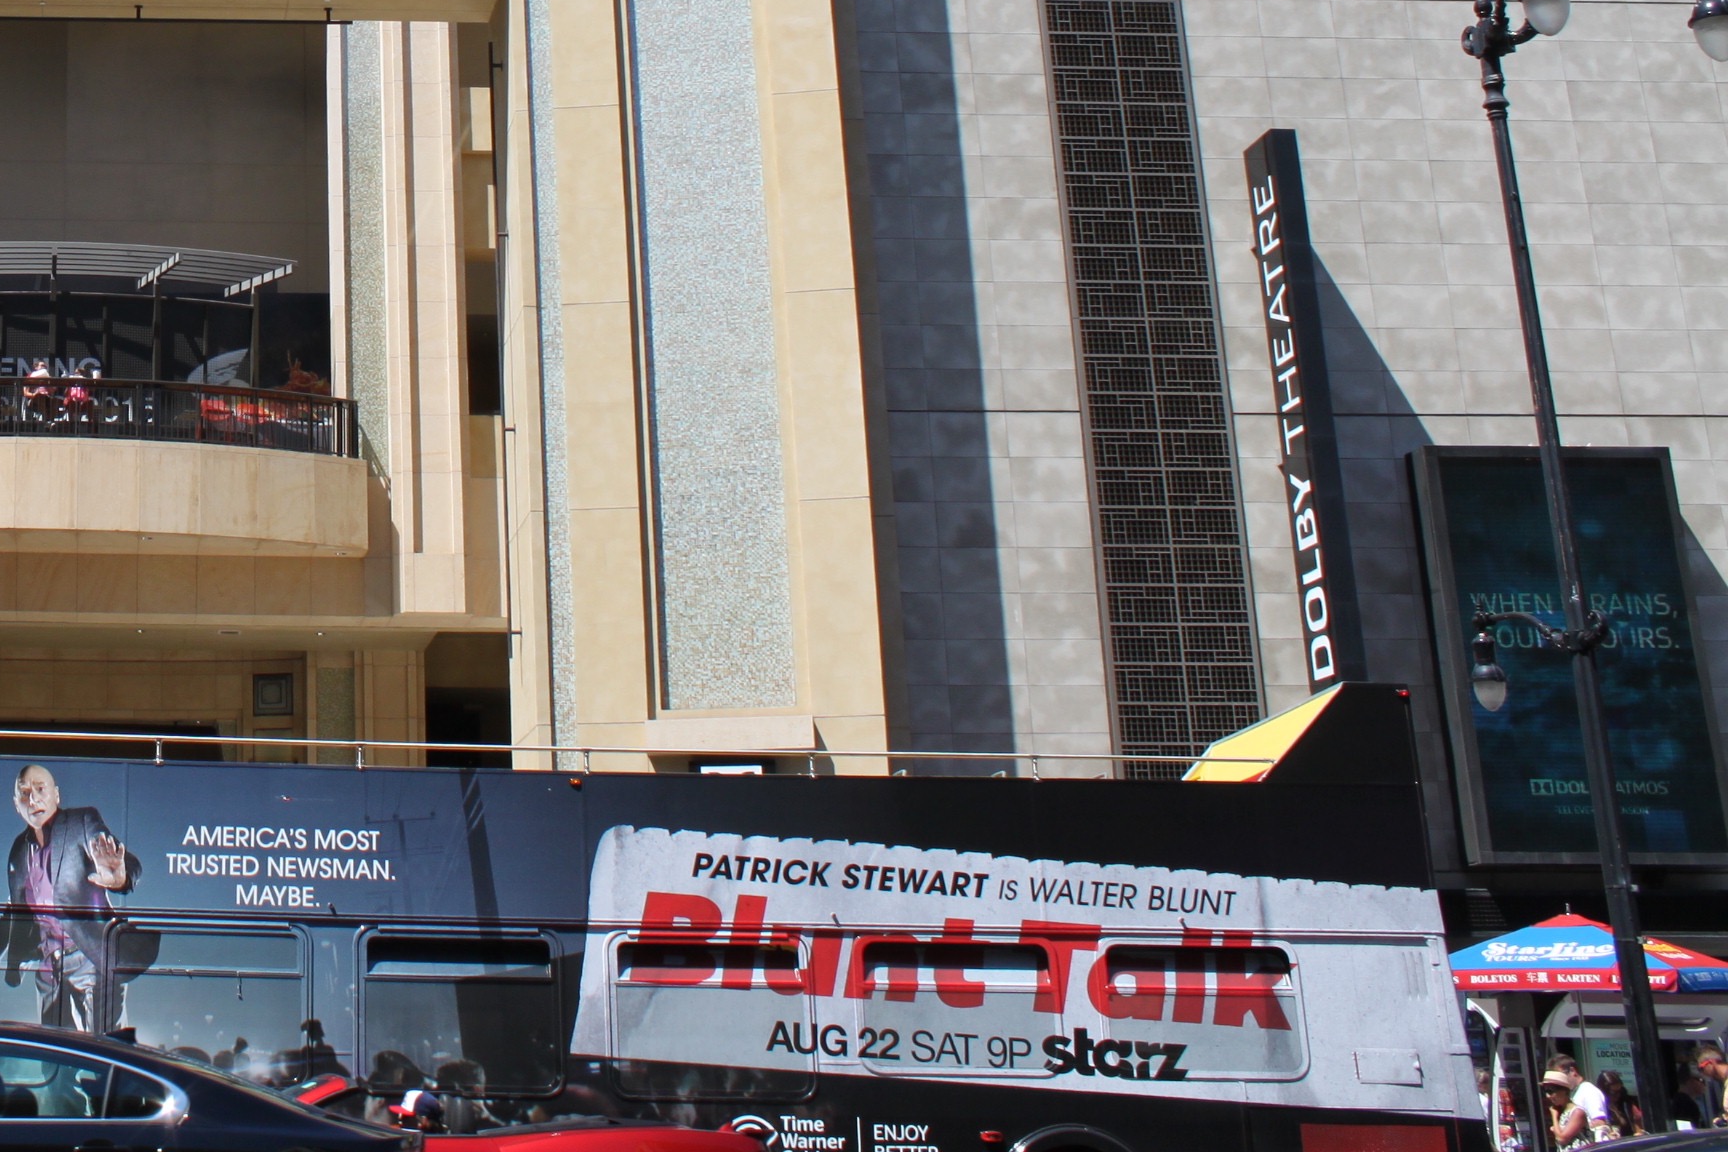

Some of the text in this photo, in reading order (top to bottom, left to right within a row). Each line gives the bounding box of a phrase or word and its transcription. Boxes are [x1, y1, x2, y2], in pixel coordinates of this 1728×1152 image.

[1253, 175, 1335, 681] DOLBY THEATRE
[1470, 592, 1554, 615] WHEN
[1599, 626, 1680, 649] OURS.
[1555, 780, 1590, 795] DOL
[182, 825, 380, 851] AMERICA'S MOST
[166, 853, 396, 881] TRUSTED NEWSMAN.
[692, 852, 1237, 916] PATRICK STEWART IS WALTER BLUNT
[236, 884, 320, 908] MAYBE.
[630, 891, 1298, 1031] Blunt Talk
[1471, 974, 1518, 984] BOLETOS
[1557, 973, 1601, 983] KARTEN
[766, 1021, 1189, 1082] AUG 22 SAT 9P starz
[780, 1115, 824, 1132] Time
[873, 1124, 929, 1141] ENJOY
[780, 1133, 845, 1149] Warner
